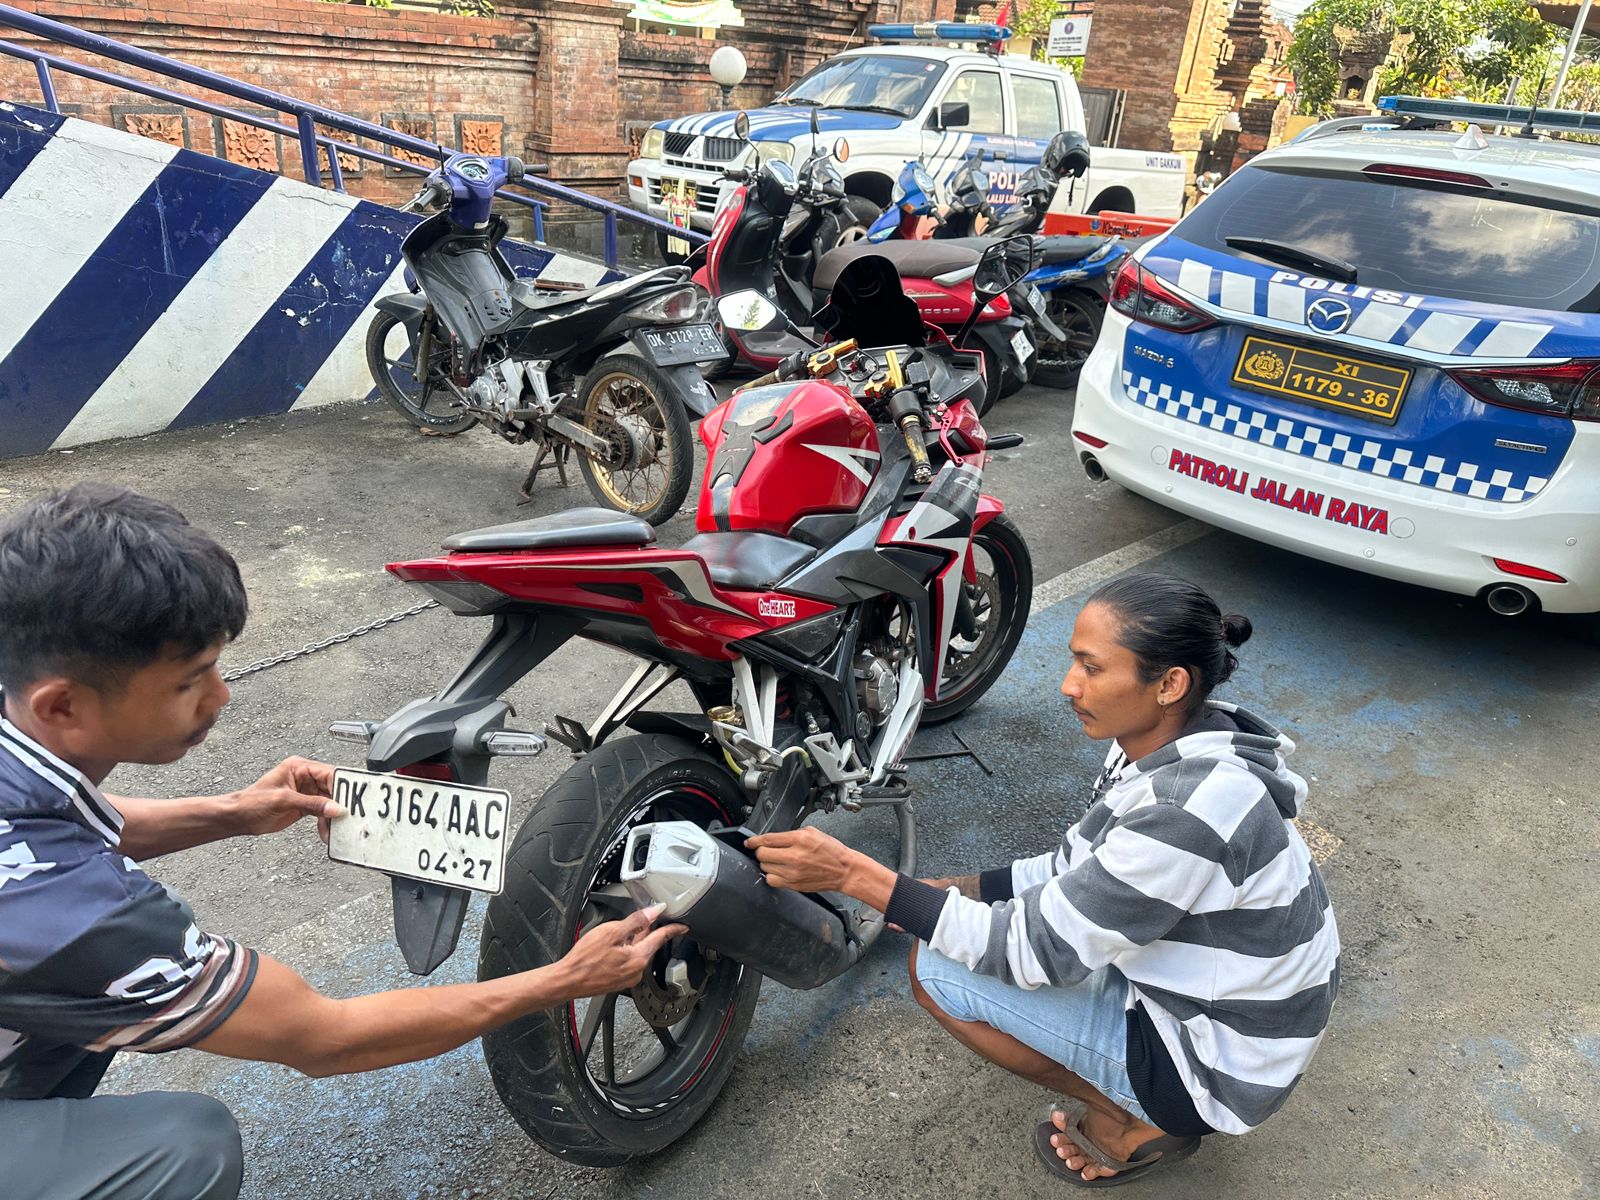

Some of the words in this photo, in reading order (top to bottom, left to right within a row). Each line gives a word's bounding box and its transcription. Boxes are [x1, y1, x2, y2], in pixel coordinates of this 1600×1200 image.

[1146, 156, 1158, 168] UNIT
[989, 172, 1021, 189] POLI
[1270, 270, 1425, 308] POLISI
[647, 333, 666, 347] DK
[698, 326, 715, 340] ER
[1332, 361, 1360, 377] XI
[1291, 372, 1343, 397] 1179
[1360, 388, 1390, 408] 36
[1168, 448, 1249, 494] PATROLI
[1250, 477, 1324, 517] JALAN
[1325, 497, 1389, 535] RAYA
[335, 777, 368, 818] DK
[377, 782, 439, 830] 3164
[447, 794, 503, 840] AAC
